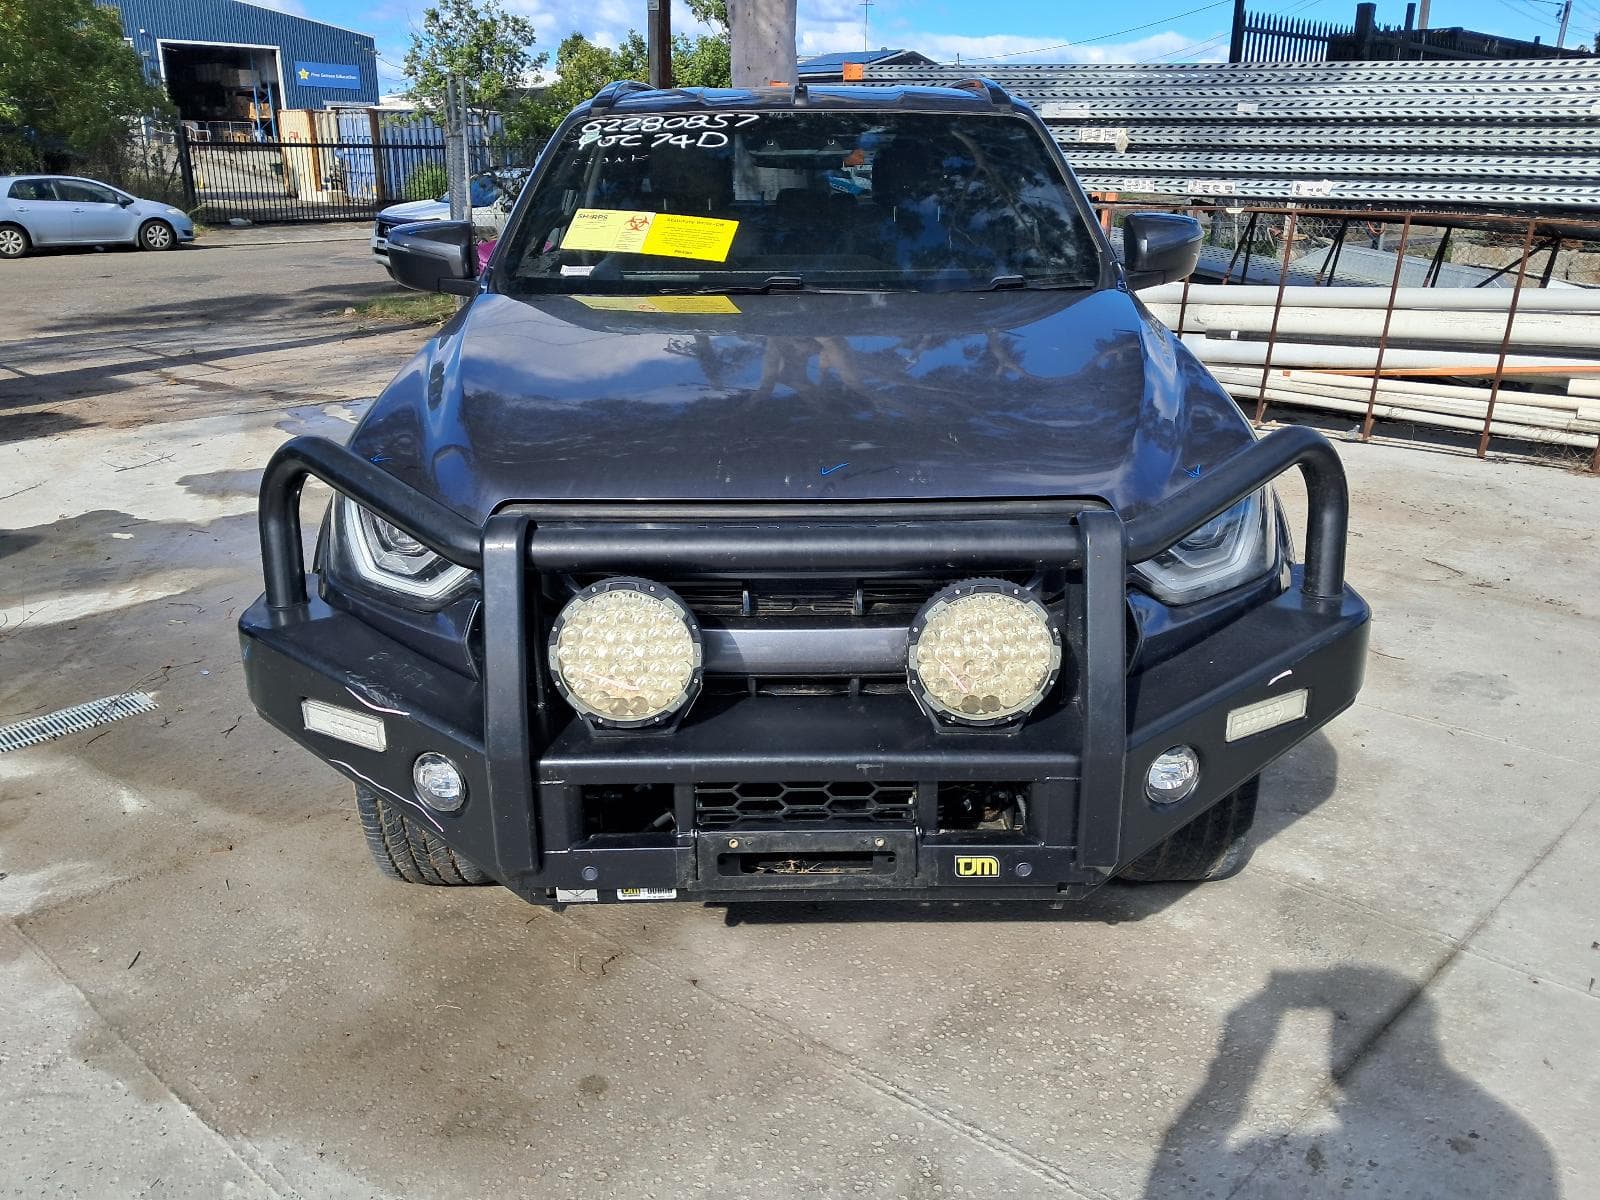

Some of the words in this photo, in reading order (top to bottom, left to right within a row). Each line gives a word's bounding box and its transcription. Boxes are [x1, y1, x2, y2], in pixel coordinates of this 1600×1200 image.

[581, 114, 760, 133] 62280857
[650, 131, 729, 149] 74D
[957, 857, 998, 876] TJM
